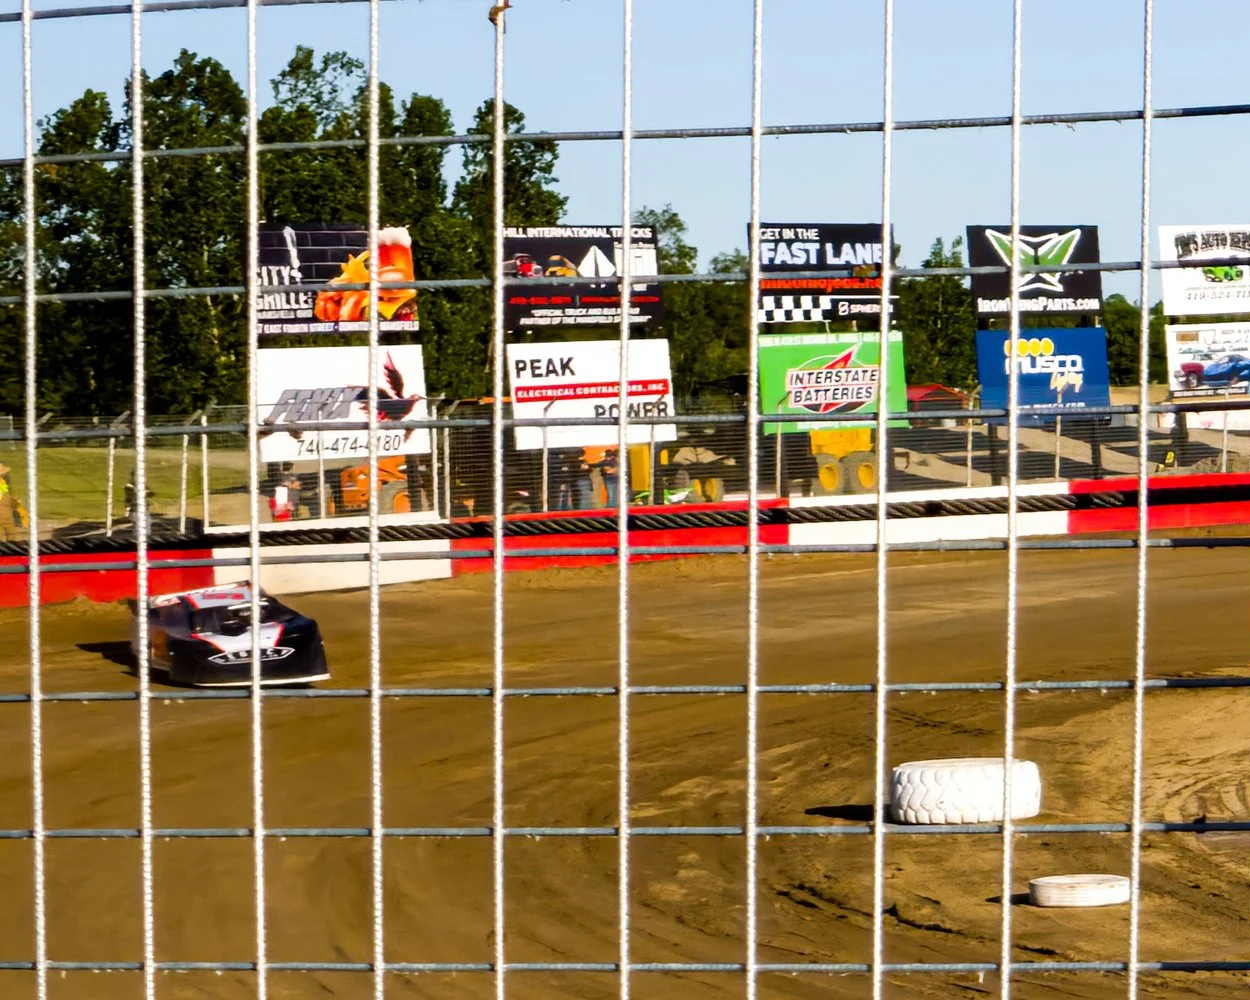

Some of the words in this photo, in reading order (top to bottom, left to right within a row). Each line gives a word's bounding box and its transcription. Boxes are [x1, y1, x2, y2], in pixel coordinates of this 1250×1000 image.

[527, 227, 611, 238] INTERNATIONAL
[612, 227, 653, 239] TRCKS
[759, 228, 780, 240] GET
[782, 229, 795, 240] IN
[796, 228, 820, 240] THE
[760, 241, 821, 265] FAST
[825, 242, 883, 265] LANE
[515, 356, 576, 379] PEAK
[789, 368, 878, 386] INTERSTATE
[517, 386, 575, 399] ELECTRICAL
[576, 383, 647, 396] CONTRACORS,
[793, 386, 873, 403] BATTERIES
